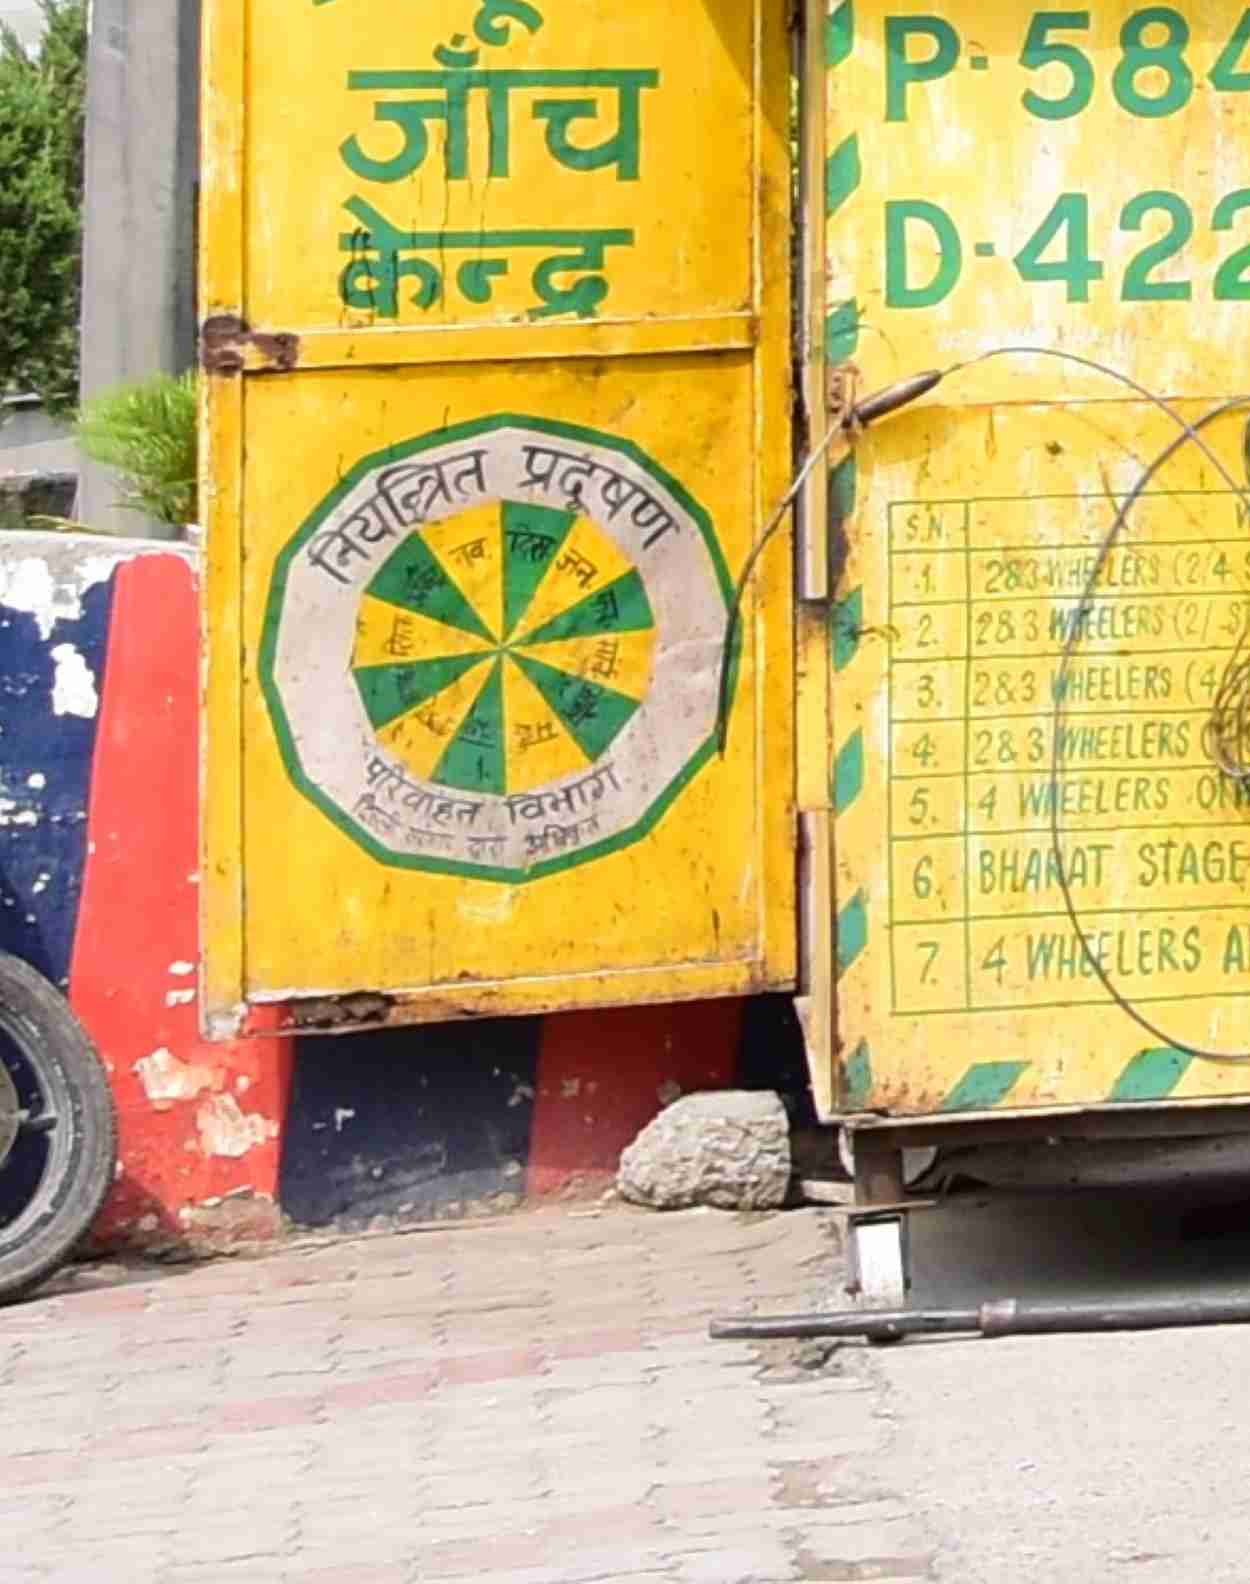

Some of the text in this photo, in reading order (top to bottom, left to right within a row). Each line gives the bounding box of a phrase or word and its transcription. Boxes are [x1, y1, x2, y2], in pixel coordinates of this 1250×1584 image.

[338, 33, 660, 183] जाँच
[338, 193, 634, 319] केन्द्र
[1055, 719, 1192, 761] WHEELERS
[979, 785, 998, 821] 4
[1018, 776, 1170, 820] WHEELERS
[978, 843, 1117, 895] BHARAT
[1138, 839, 1247, 888] STAGE
[981, 935, 1008, 984] 4
[1026, 925, 1202, 982] WHEELERS
